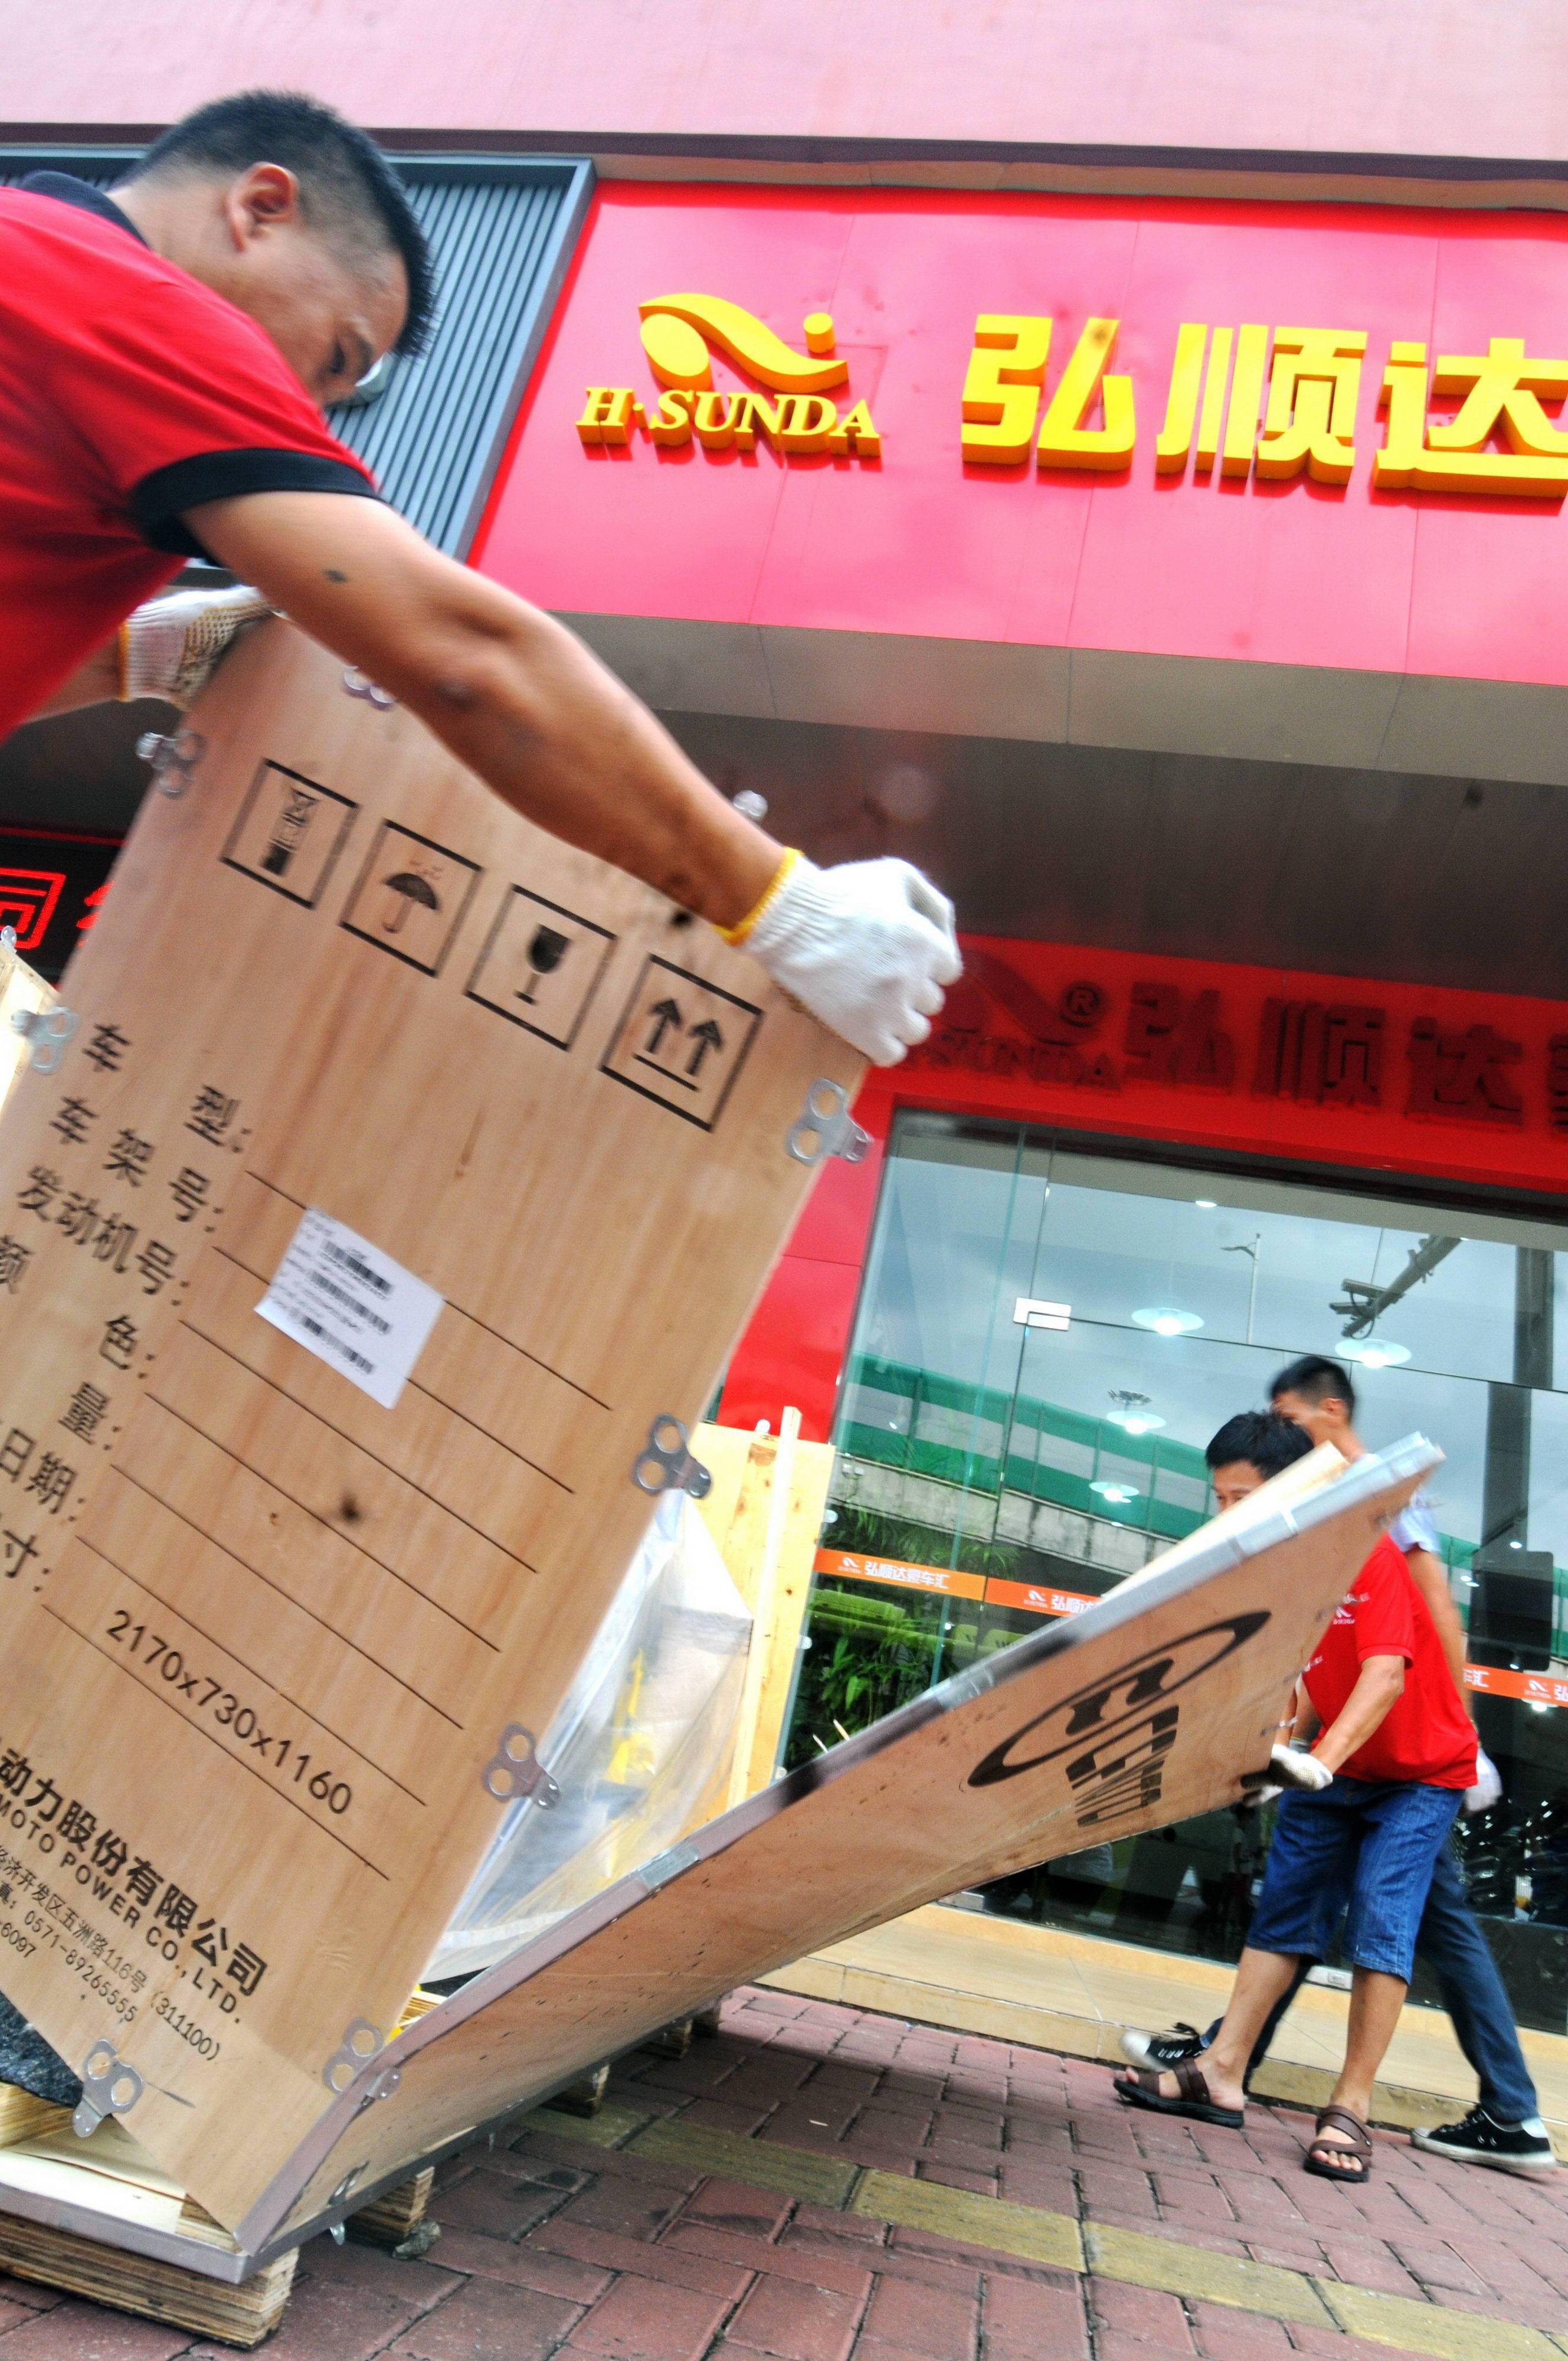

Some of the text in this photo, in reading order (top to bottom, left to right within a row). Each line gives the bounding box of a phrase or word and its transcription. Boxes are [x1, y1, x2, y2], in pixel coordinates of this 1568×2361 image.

[961, 313, 1568, 498] 弘顺达
[1123, 981, 1568, 1130] 弘顺达
[0, 1748, 267, 1997] 动力股份有限公司
[60, 1850, 141, 1930] POWER
